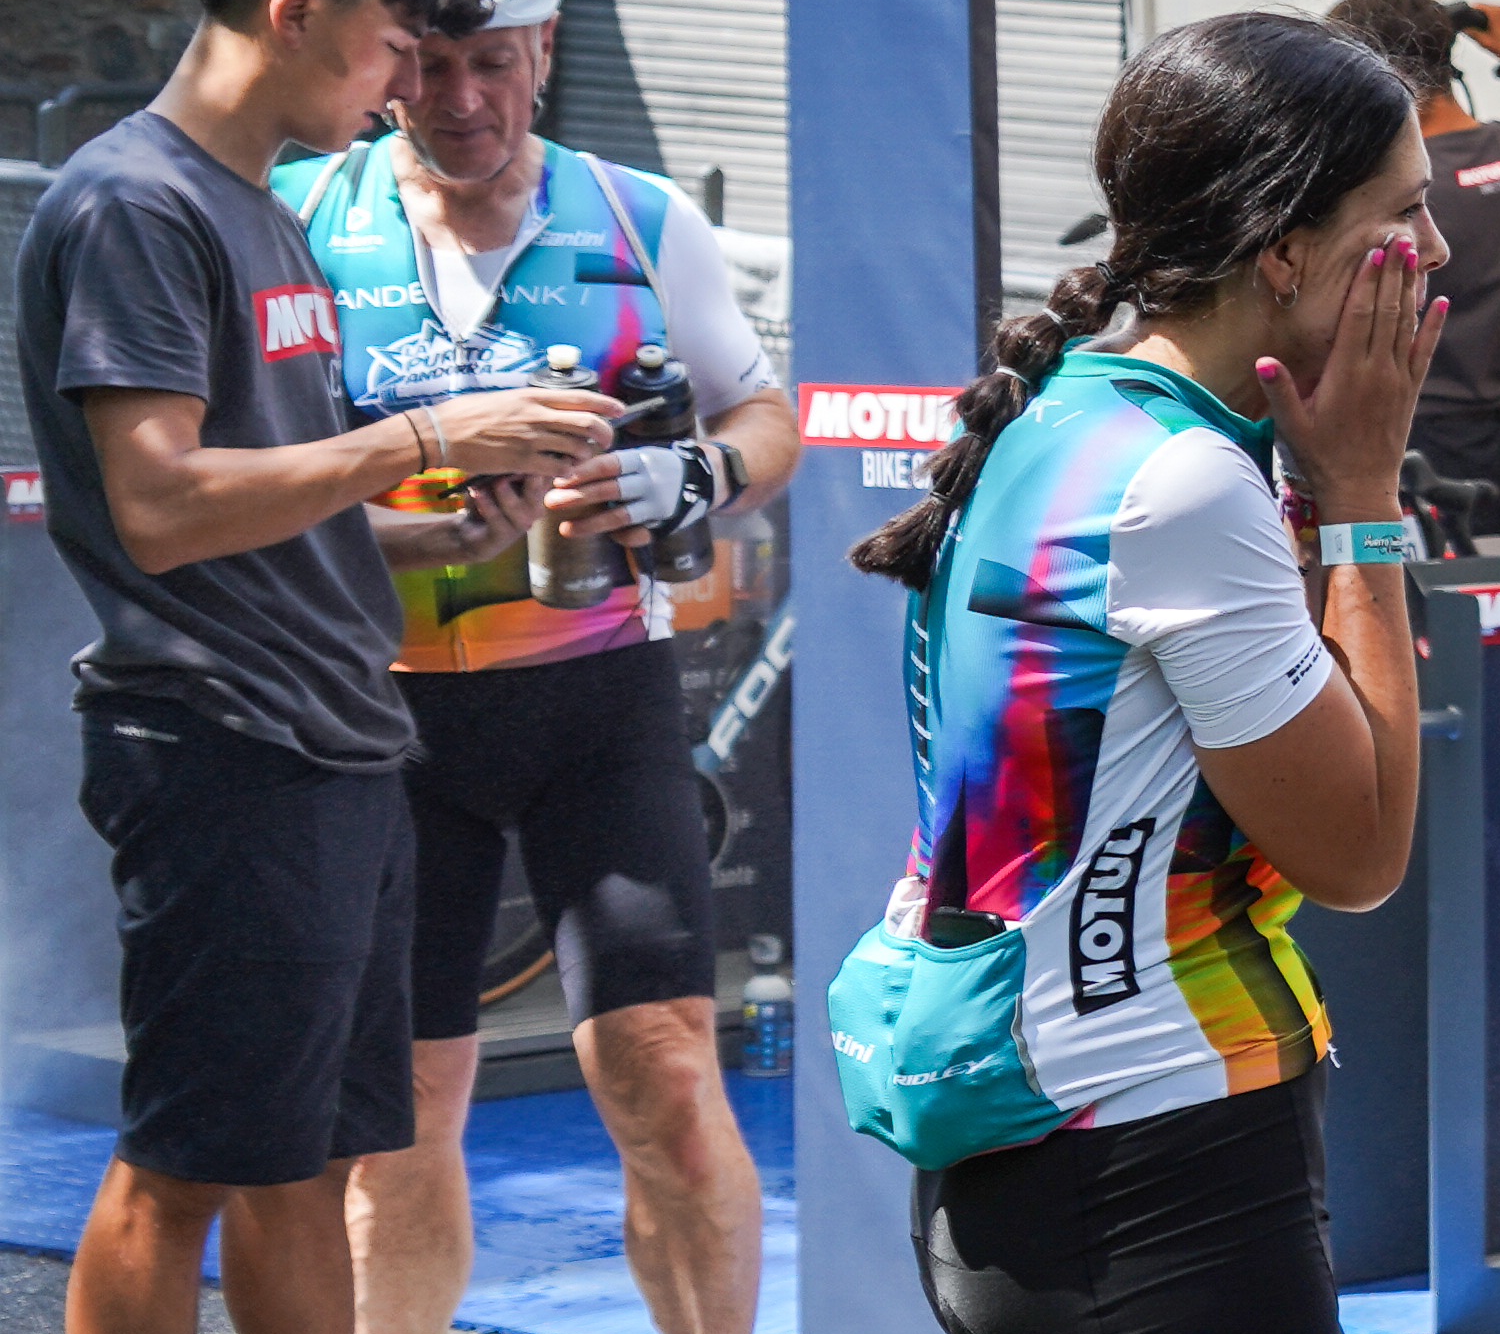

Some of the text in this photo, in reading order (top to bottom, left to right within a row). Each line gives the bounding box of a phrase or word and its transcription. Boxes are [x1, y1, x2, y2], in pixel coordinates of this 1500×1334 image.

[862, 451, 911, 489] BIKE
[706, 616, 793, 759] FOC
[831, 1031, 876, 1063] tini
[892, 1053, 995, 1086] RIDLEY
